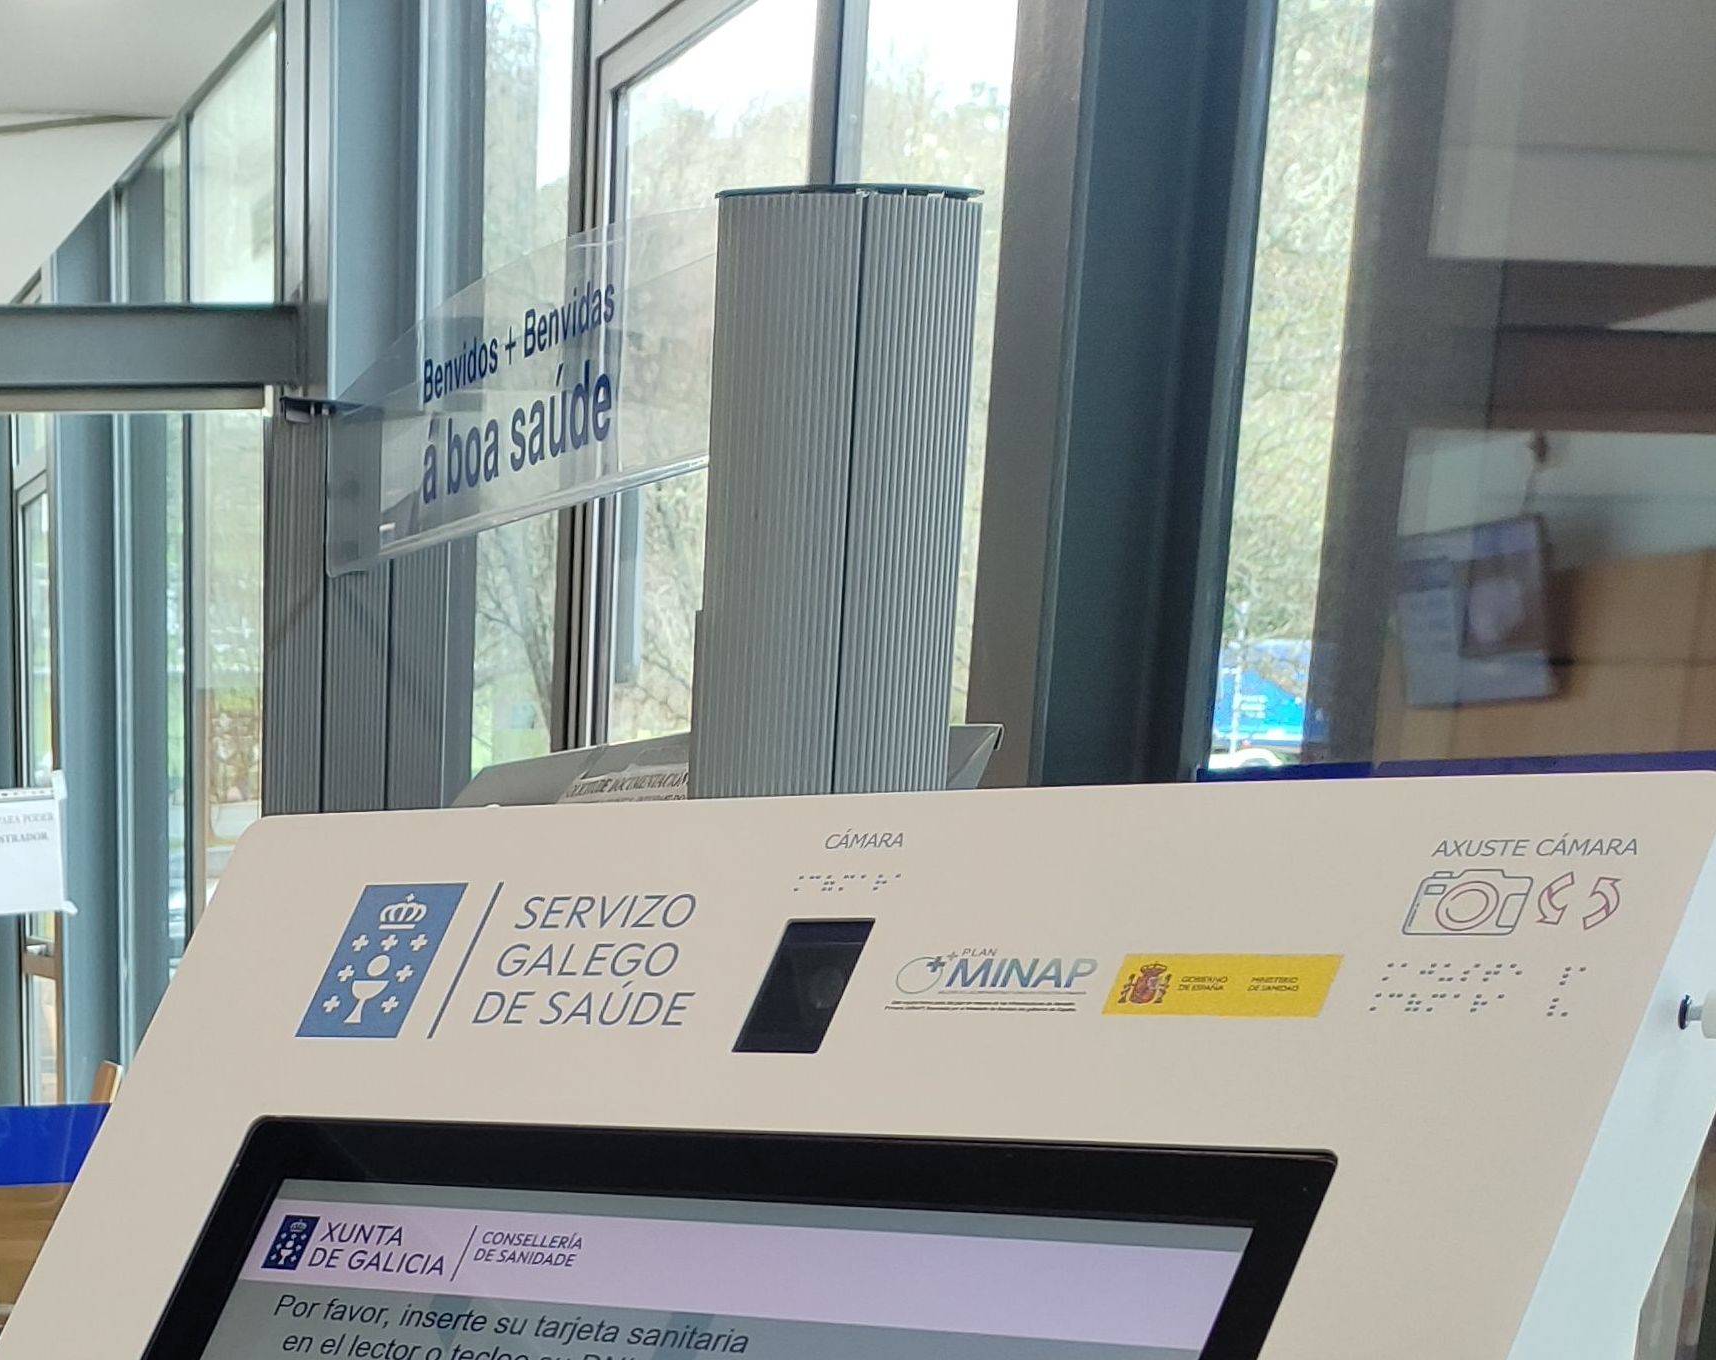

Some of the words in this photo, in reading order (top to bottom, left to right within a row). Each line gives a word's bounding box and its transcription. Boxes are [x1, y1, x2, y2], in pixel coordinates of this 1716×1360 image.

[423, 336, 500, 404] Benvidos
[524, 281, 616, 359] Benvidas
[446, 418, 500, 495] boa
[510, 358, 613, 472] saúde
[824, 828, 905, 850] CÁMARA
[1431, 839, 1530, 857] AXUSTE
[1535, 832, 1638, 857] CÁMARA
[513, 893, 697, 930] SERVIZO
[495, 941, 682, 978] GALEGO
[961, 948, 998, 957] PLAN
[944, 958, 1099, 988] MINAP
[1192, 983, 1224, 991] ESPAÑA
[472, 989, 536, 1025] DE
[539, 982, 696, 1027] SAÚDE
[319, 1222, 404, 1246] XUNTA
[482, 1231, 583, 1250] CONSELLERÍA
[308, 1247, 344, 1268] DE
[347, 1249, 445, 1276] GALICIA
[473, 1249, 496, 1262] DE
[497, 1249, 577, 1268] SANIDADE
[274, 1294, 320, 1321] Por
[323, 1298, 391, 1329] favor,
[399, 1304, 488, 1334] inserte
[494, 1315, 527, 1336] su
[534, 1316, 620, 1347] tarjeta
[627, 1323, 750, 1355] sanitaria
[283, 1334, 315, 1354] en
[320, 1332, 344, 1357] el
